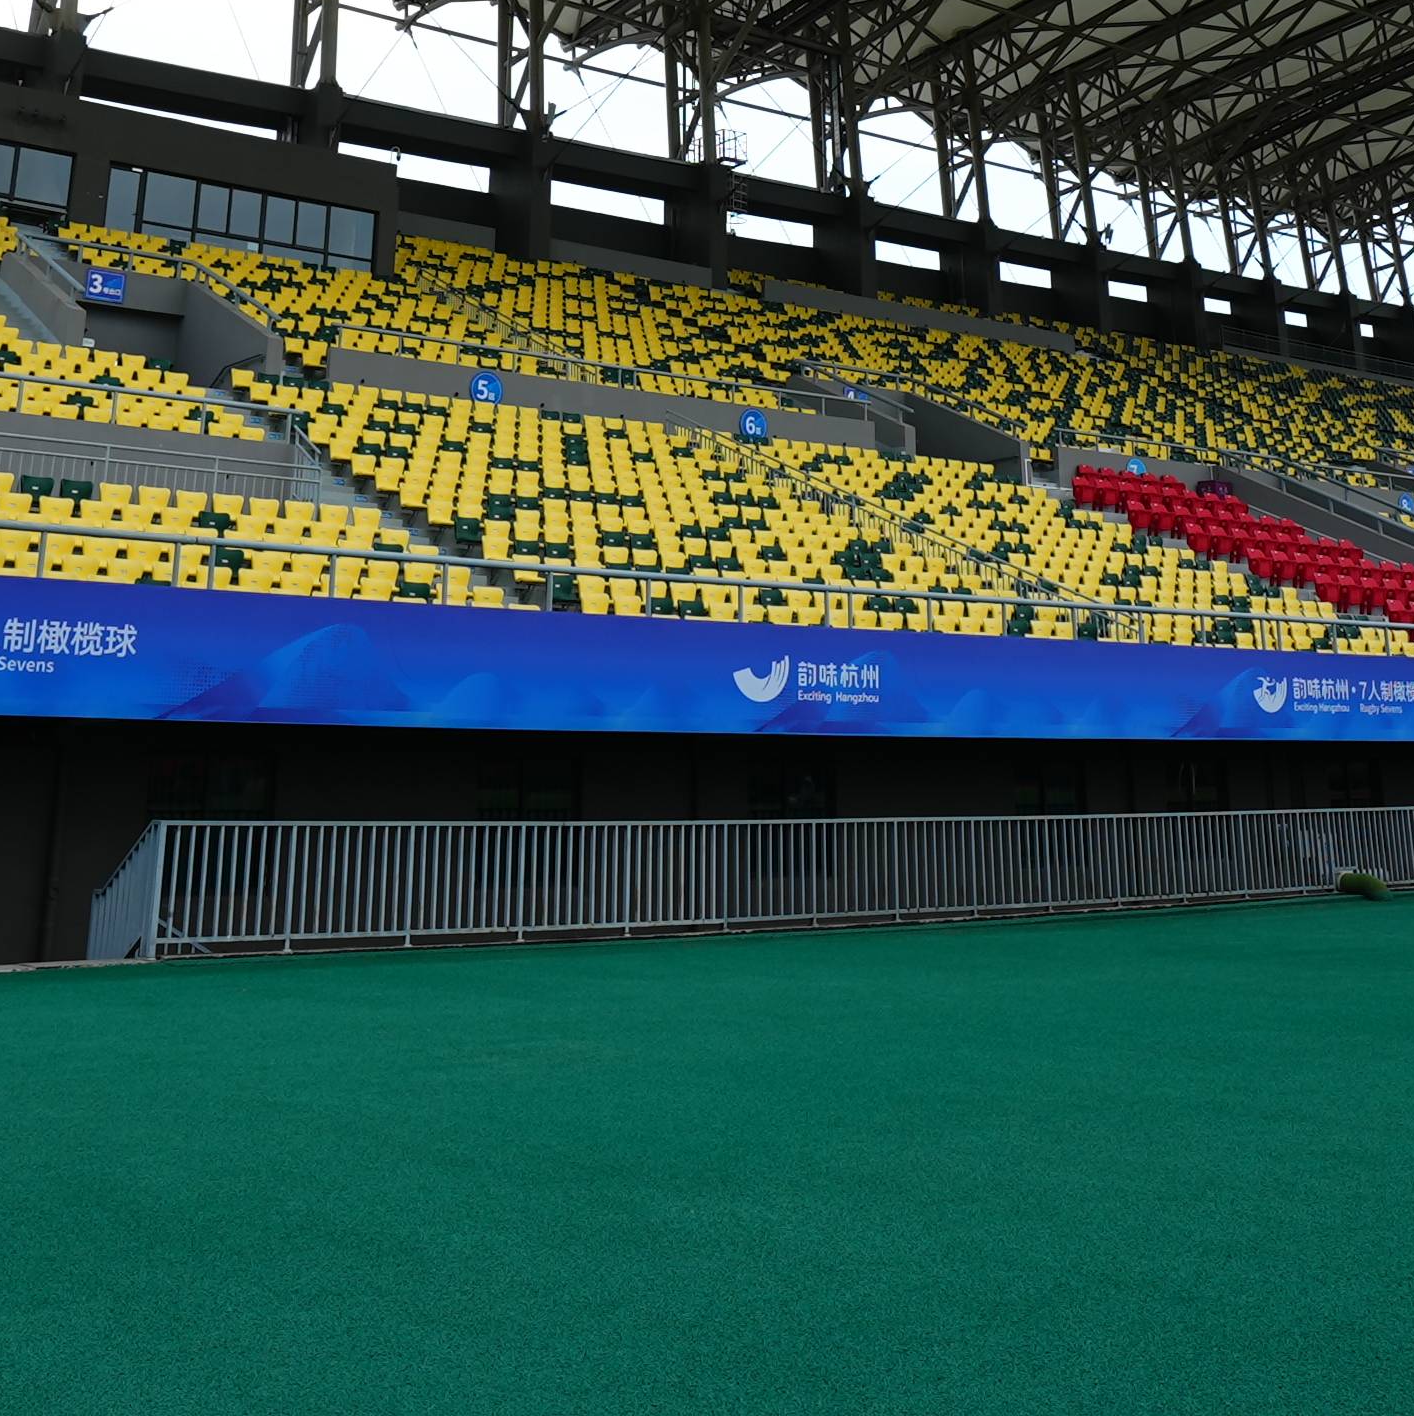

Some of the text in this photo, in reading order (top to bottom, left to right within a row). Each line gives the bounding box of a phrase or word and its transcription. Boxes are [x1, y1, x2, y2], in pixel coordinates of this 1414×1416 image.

[798, 661, 879, 689] 韵味杭州
[798, 690, 879, 705] Exciting Hangzhou
